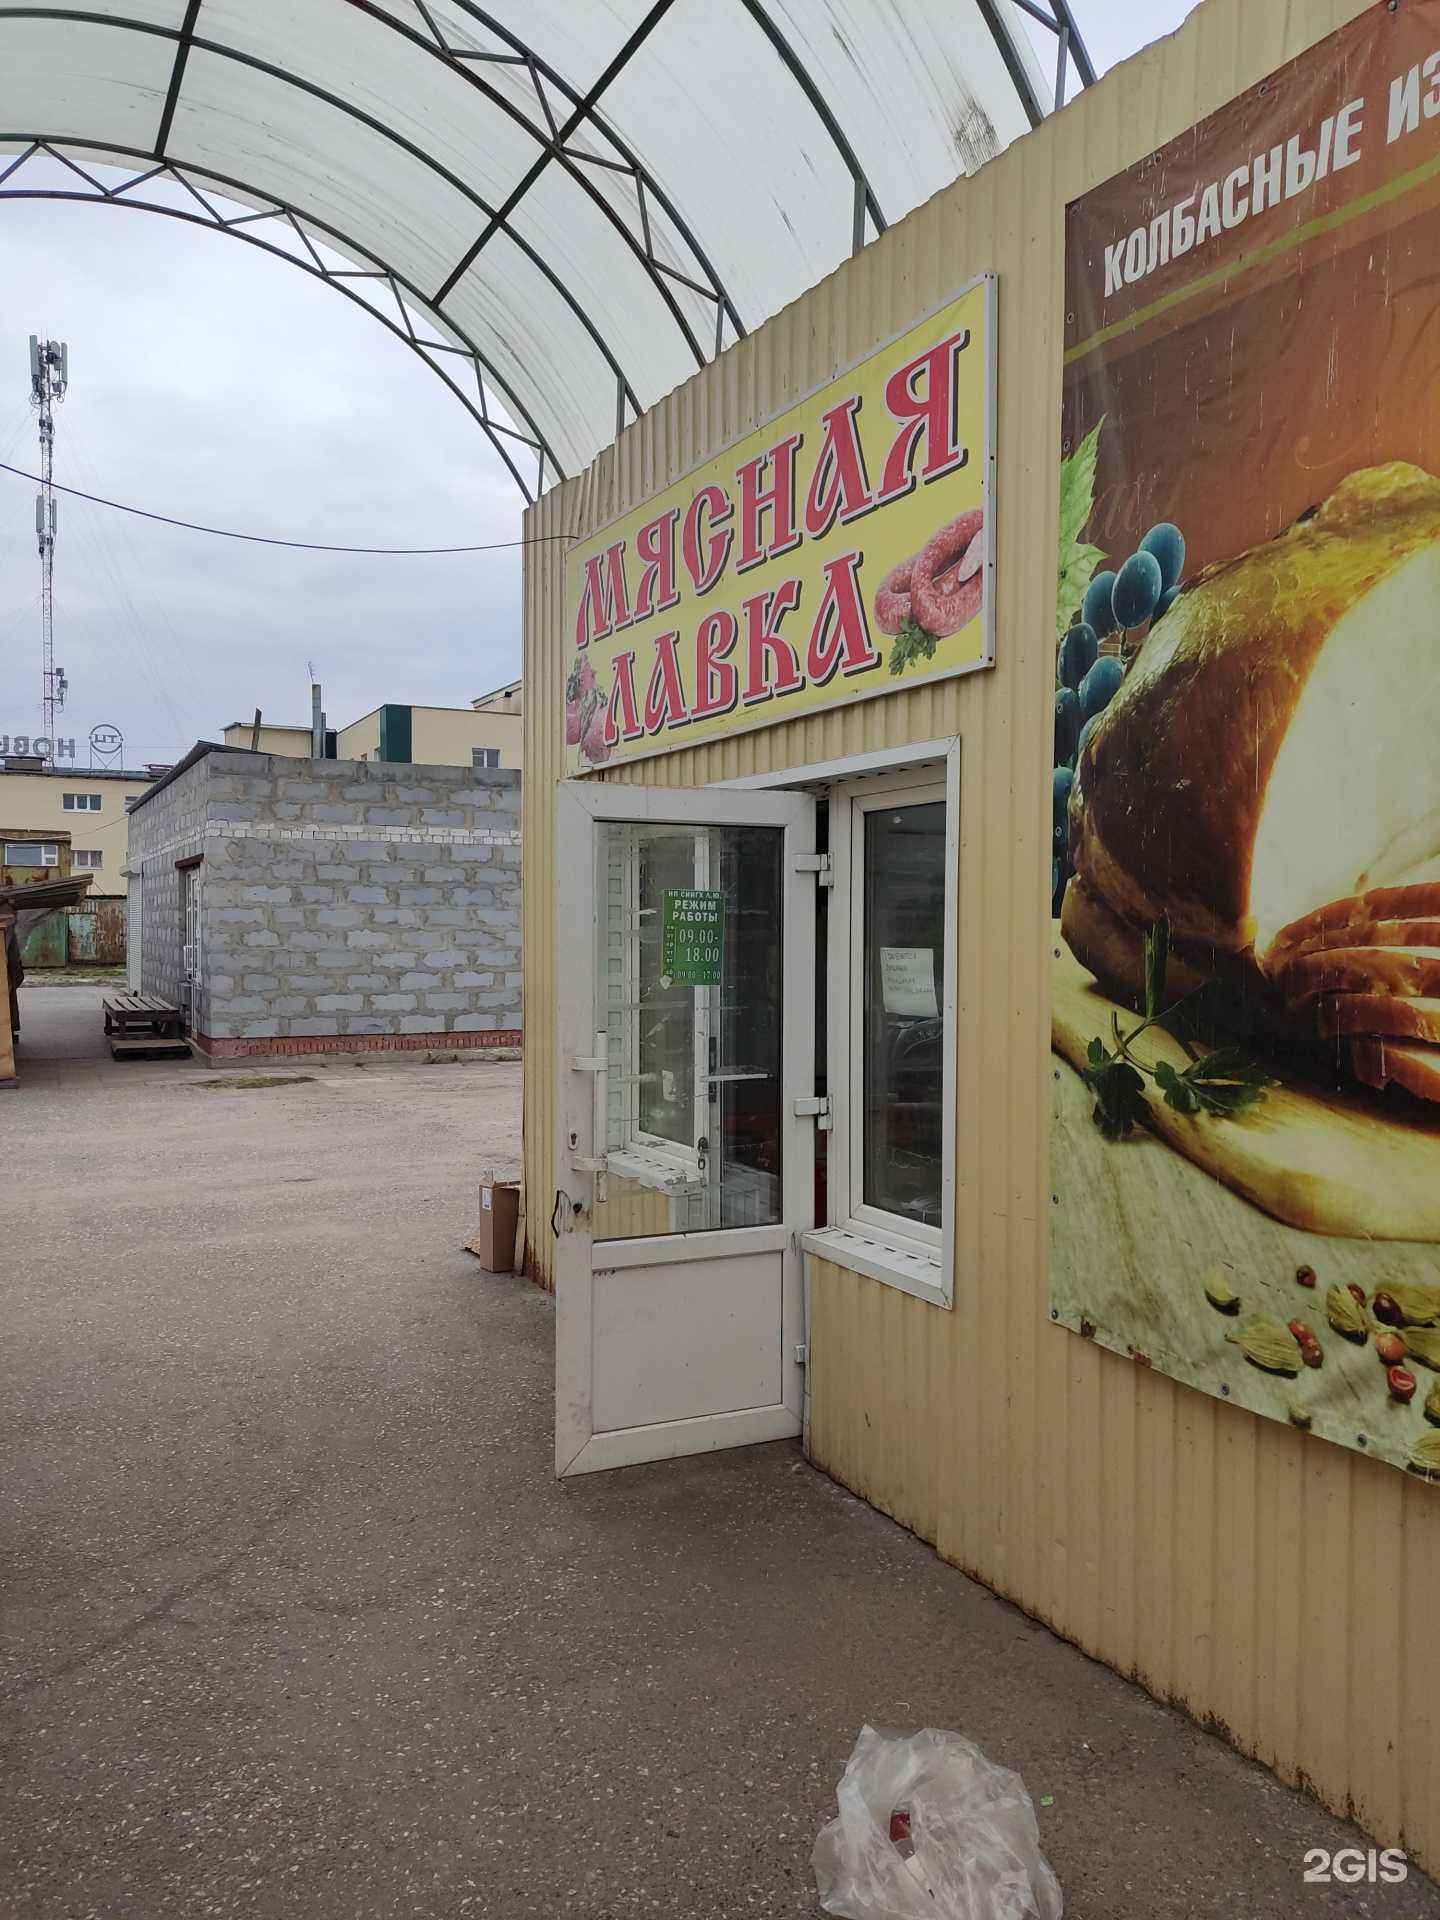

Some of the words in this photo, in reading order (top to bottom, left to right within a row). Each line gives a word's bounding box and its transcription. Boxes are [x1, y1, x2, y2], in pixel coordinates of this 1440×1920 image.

[1104, 97, 1365, 298] КОЛБАСНЫЕ
[576, 329, 970, 650] МЯСНАЯ
[603, 551, 882, 746] ЛАВКА
[672, 911, 718, 922] РАБОТЫ
[674, 899, 716, 910] РЕЖИМ
[685, 947, 719, 962] 18.00
